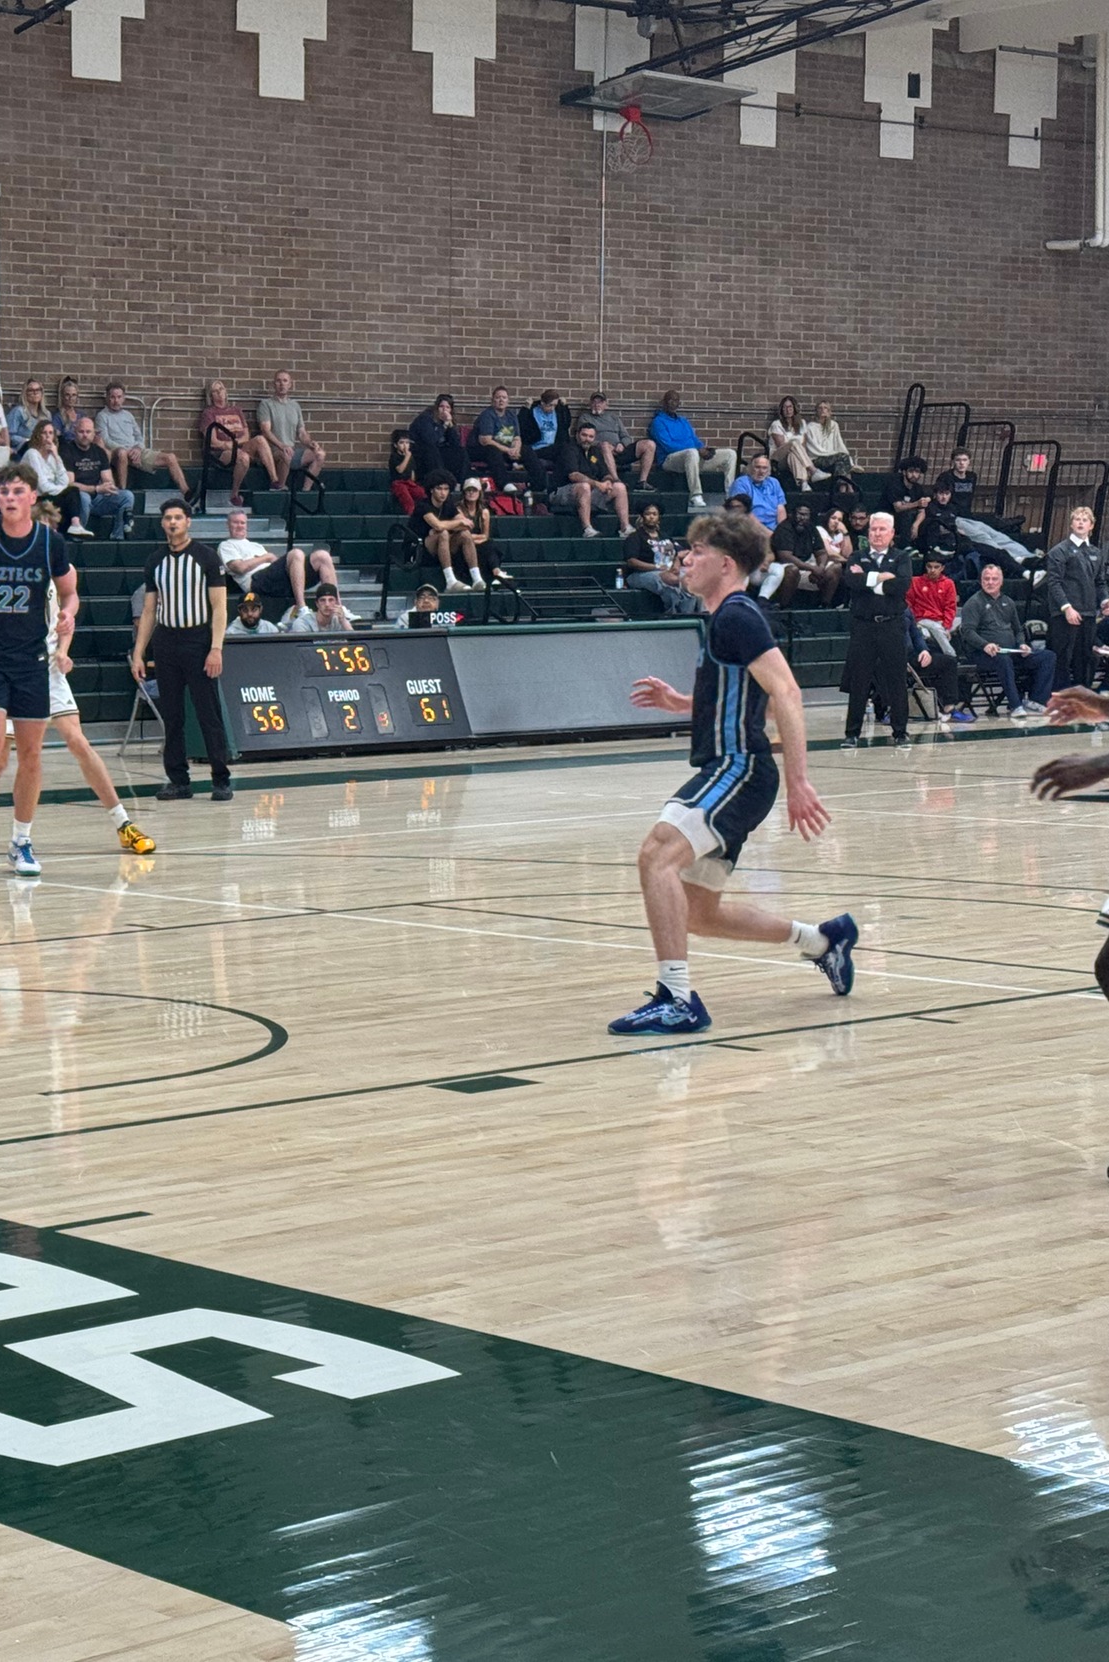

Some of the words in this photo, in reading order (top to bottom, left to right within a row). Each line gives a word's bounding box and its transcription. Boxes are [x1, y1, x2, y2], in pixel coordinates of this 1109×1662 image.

[430, 612, 457, 624] POSS
[316, 646, 370, 673] 7:56
[240, 686, 277, 703] HOME
[327, 689, 360, 702] PERIOD
[406, 679, 442, 695] GUEST
[253, 705, 285, 732] 56
[342, 704, 357, 730] 2
[419, 697, 450, 722] 61
